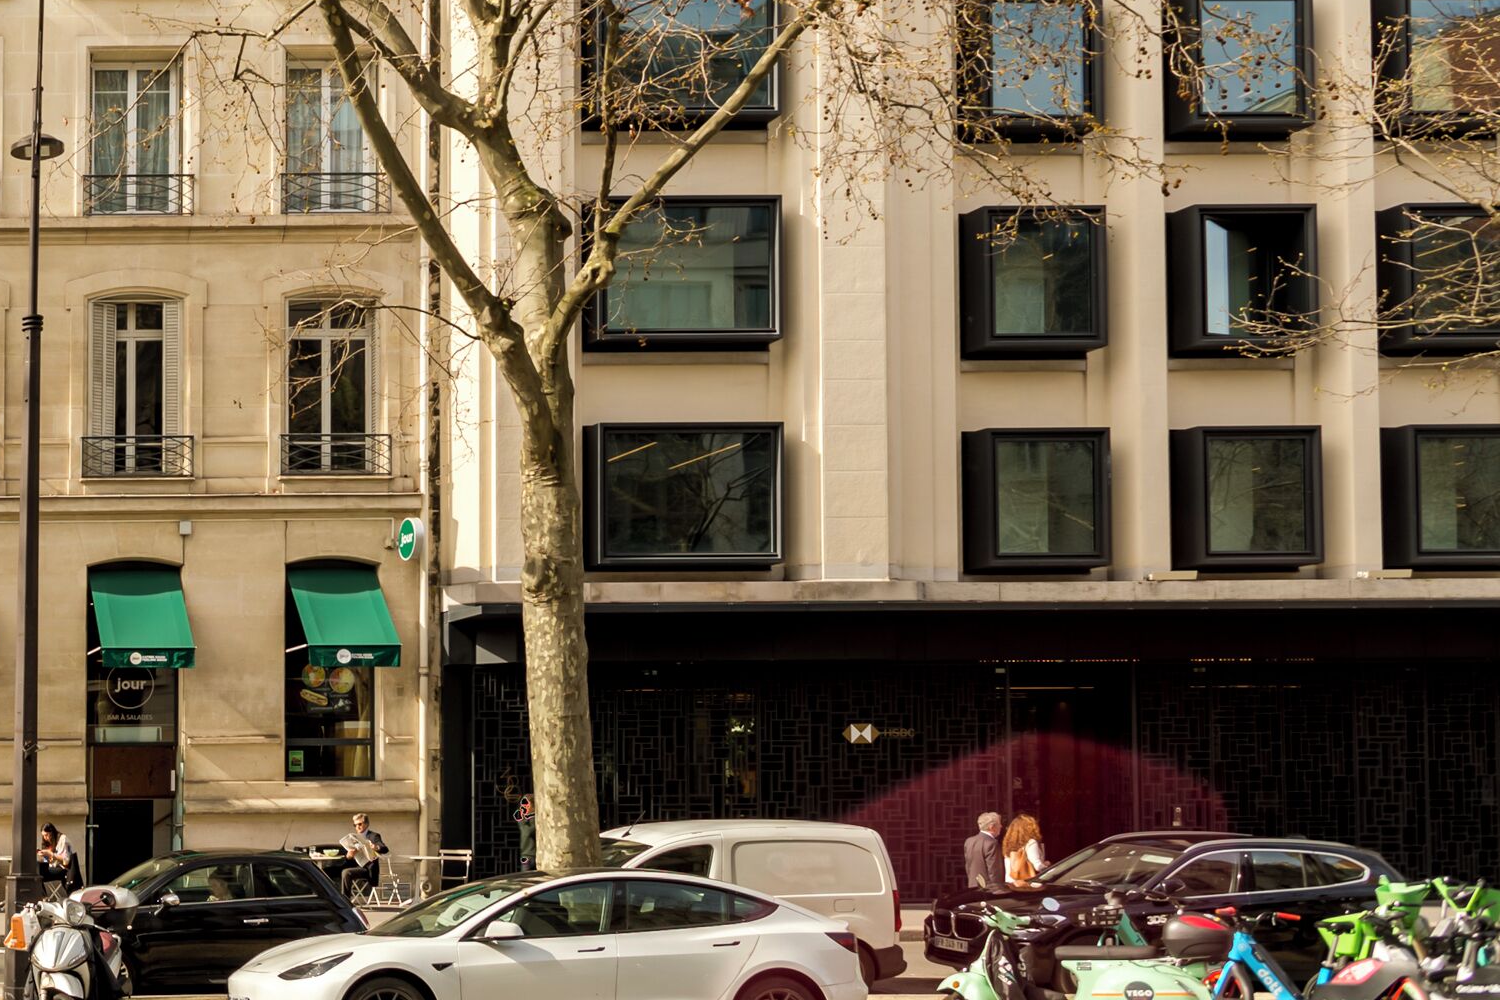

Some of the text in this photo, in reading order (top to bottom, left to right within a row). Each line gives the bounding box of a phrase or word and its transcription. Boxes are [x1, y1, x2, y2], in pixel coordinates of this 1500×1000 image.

[400, 532, 414, 548] jour
[114, 677, 147, 693] jour
[120, 713, 126, 721] À
[883, 727, 916, 738] HSBC
[1126, 989, 1153, 997] YEGO
